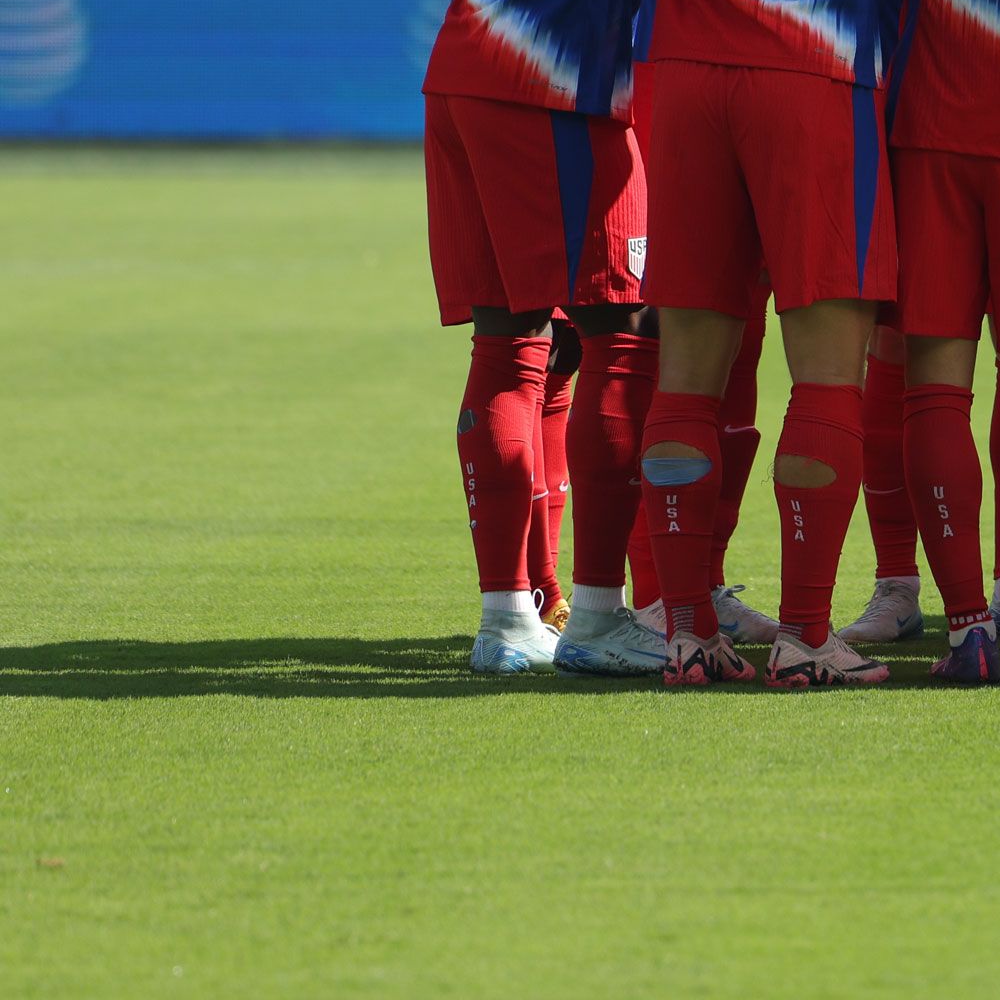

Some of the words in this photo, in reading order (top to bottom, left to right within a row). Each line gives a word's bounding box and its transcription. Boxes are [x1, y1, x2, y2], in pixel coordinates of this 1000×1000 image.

[466, 462, 477, 508] USA
[665, 494, 681, 533] USA
[791, 500, 806, 542] USA
[933, 485, 955, 539] USA
